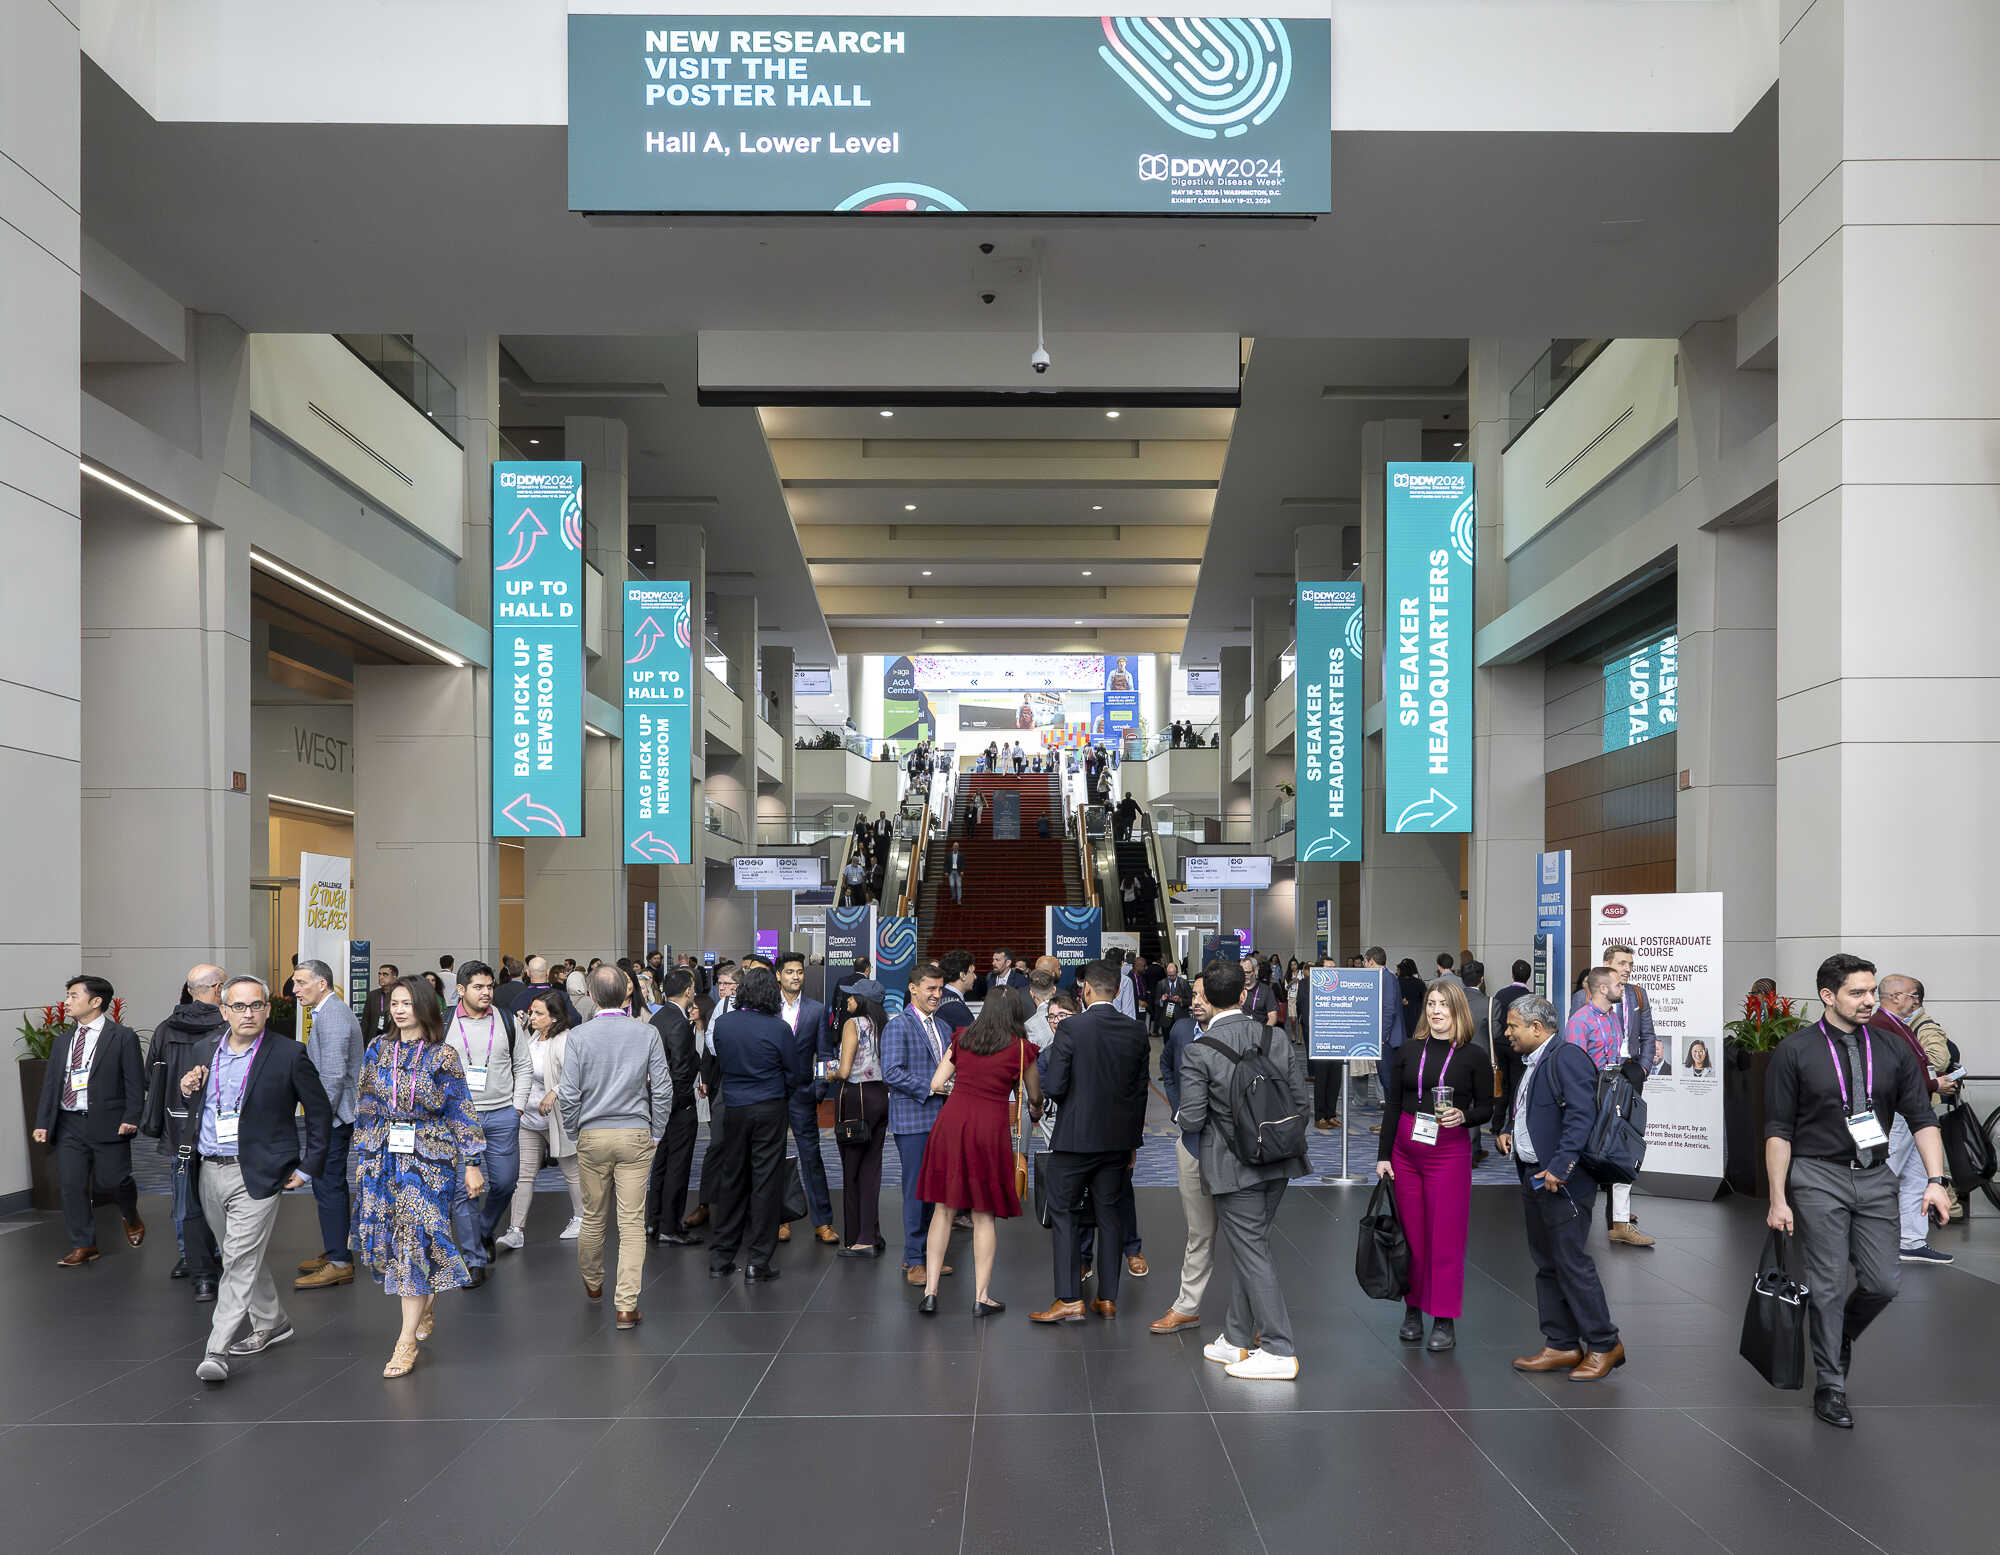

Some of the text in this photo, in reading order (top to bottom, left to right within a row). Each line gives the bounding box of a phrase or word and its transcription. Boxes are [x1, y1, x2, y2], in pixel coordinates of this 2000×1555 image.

[645, 31, 905, 53] NEW RESEARCH
[644, 57, 808, 80] VISIT THE
[646, 84, 872, 107] POSTER HALL
[646, 131, 899, 157] Hall A, Lower Level
[1170, 158, 1283, 178] DDW2024
[1171, 178, 1214, 187] Digestive
[1217, 178, 1253, 186] Disease
[516, 475, 573, 486] DDW2024
[1409, 476, 1465, 486] DDW2024
[505, 581, 568, 596] UP TO
[640, 592, 684, 600] DDW2024
[1314, 592, 1356, 600] DDW2024
[500, 603, 574, 617] HALL D
[1400, 597, 1419, 726] SPEAKER
[1429, 549, 1449, 774] HEADQUARTERS
[632, 671, 680, 682] UP TO
[628, 687, 685, 699] HALL D
[514, 637, 530, 777] BAG PICK UP
[537, 644, 553, 770] NEWSROOM
[1307, 683, 1322, 782] SPEAKER
[1329, 647, 1345, 817] HEADQUARTERS
[294, 726, 348, 773] WEST
[640, 713, 652, 818] BAG PICK UP
[657, 718, 669, 814] NEWSROOM
[309, 884, 347, 911] 2 TOUGH
[307, 906, 348, 931] DISEASES
[1604, 907, 1625, 915] ASGE
[1601, 936, 1712, 946] ANNUAL POSTGRADUATE
[828, 950, 853, 959] MEETING
[1056, 950, 1084, 958] MEETING
[1637, 947, 1674, 957] COURSE
[1650, 965, 1668, 973] NEW
[1669, 965, 1708, 973] ADVANCES
[1631, 974, 1693, 982] MPROVE PATIENT
